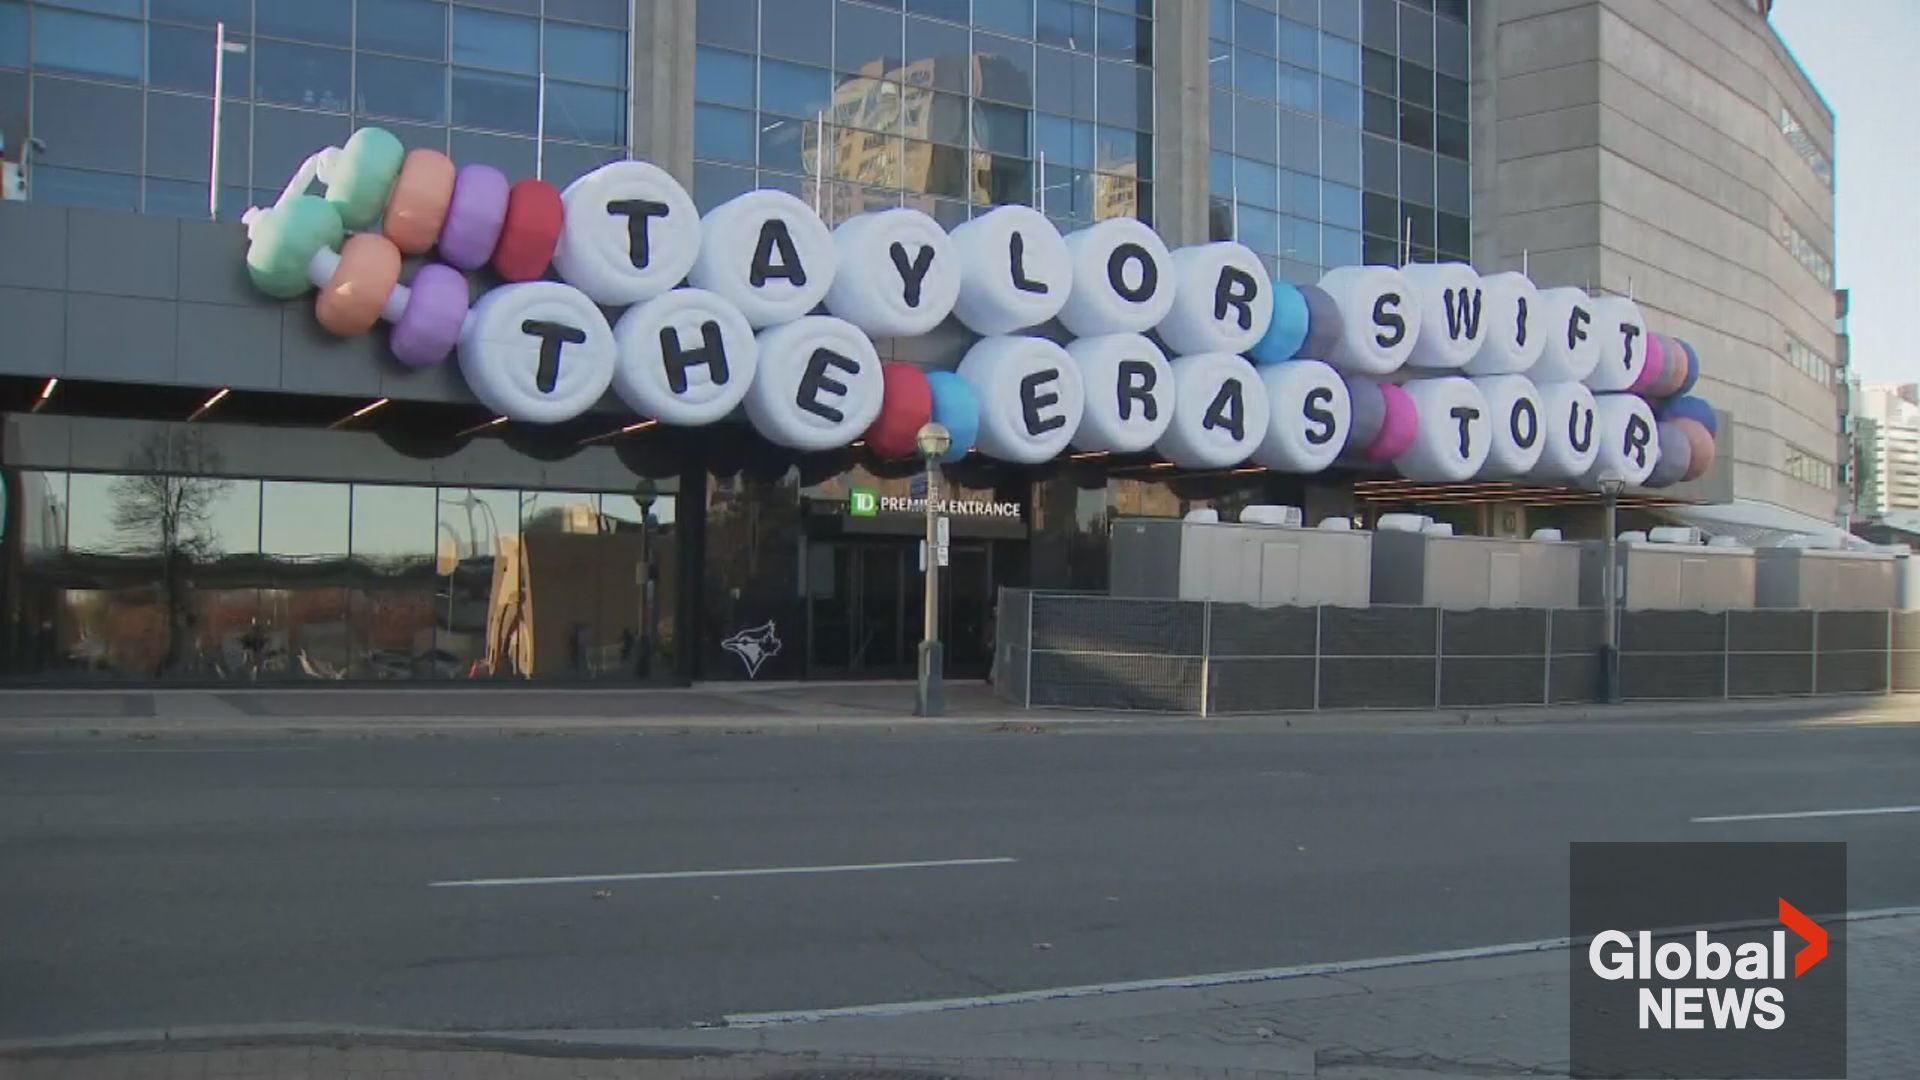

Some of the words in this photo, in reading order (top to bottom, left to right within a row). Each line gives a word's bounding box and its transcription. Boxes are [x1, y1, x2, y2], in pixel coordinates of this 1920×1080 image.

[607, 199, 1258, 331] TAYLOR
[1372, 287, 1640, 371] SWIFT
[521, 319, 860, 423] THE
[1019, 359, 1336, 444] ERAS
[1450, 396, 1650, 467] TOUR
[852, 492, 874, 512] TD
[881, 496, 946, 513] PREMIM
[950, 500, 1021, 517] ENTRANCE
